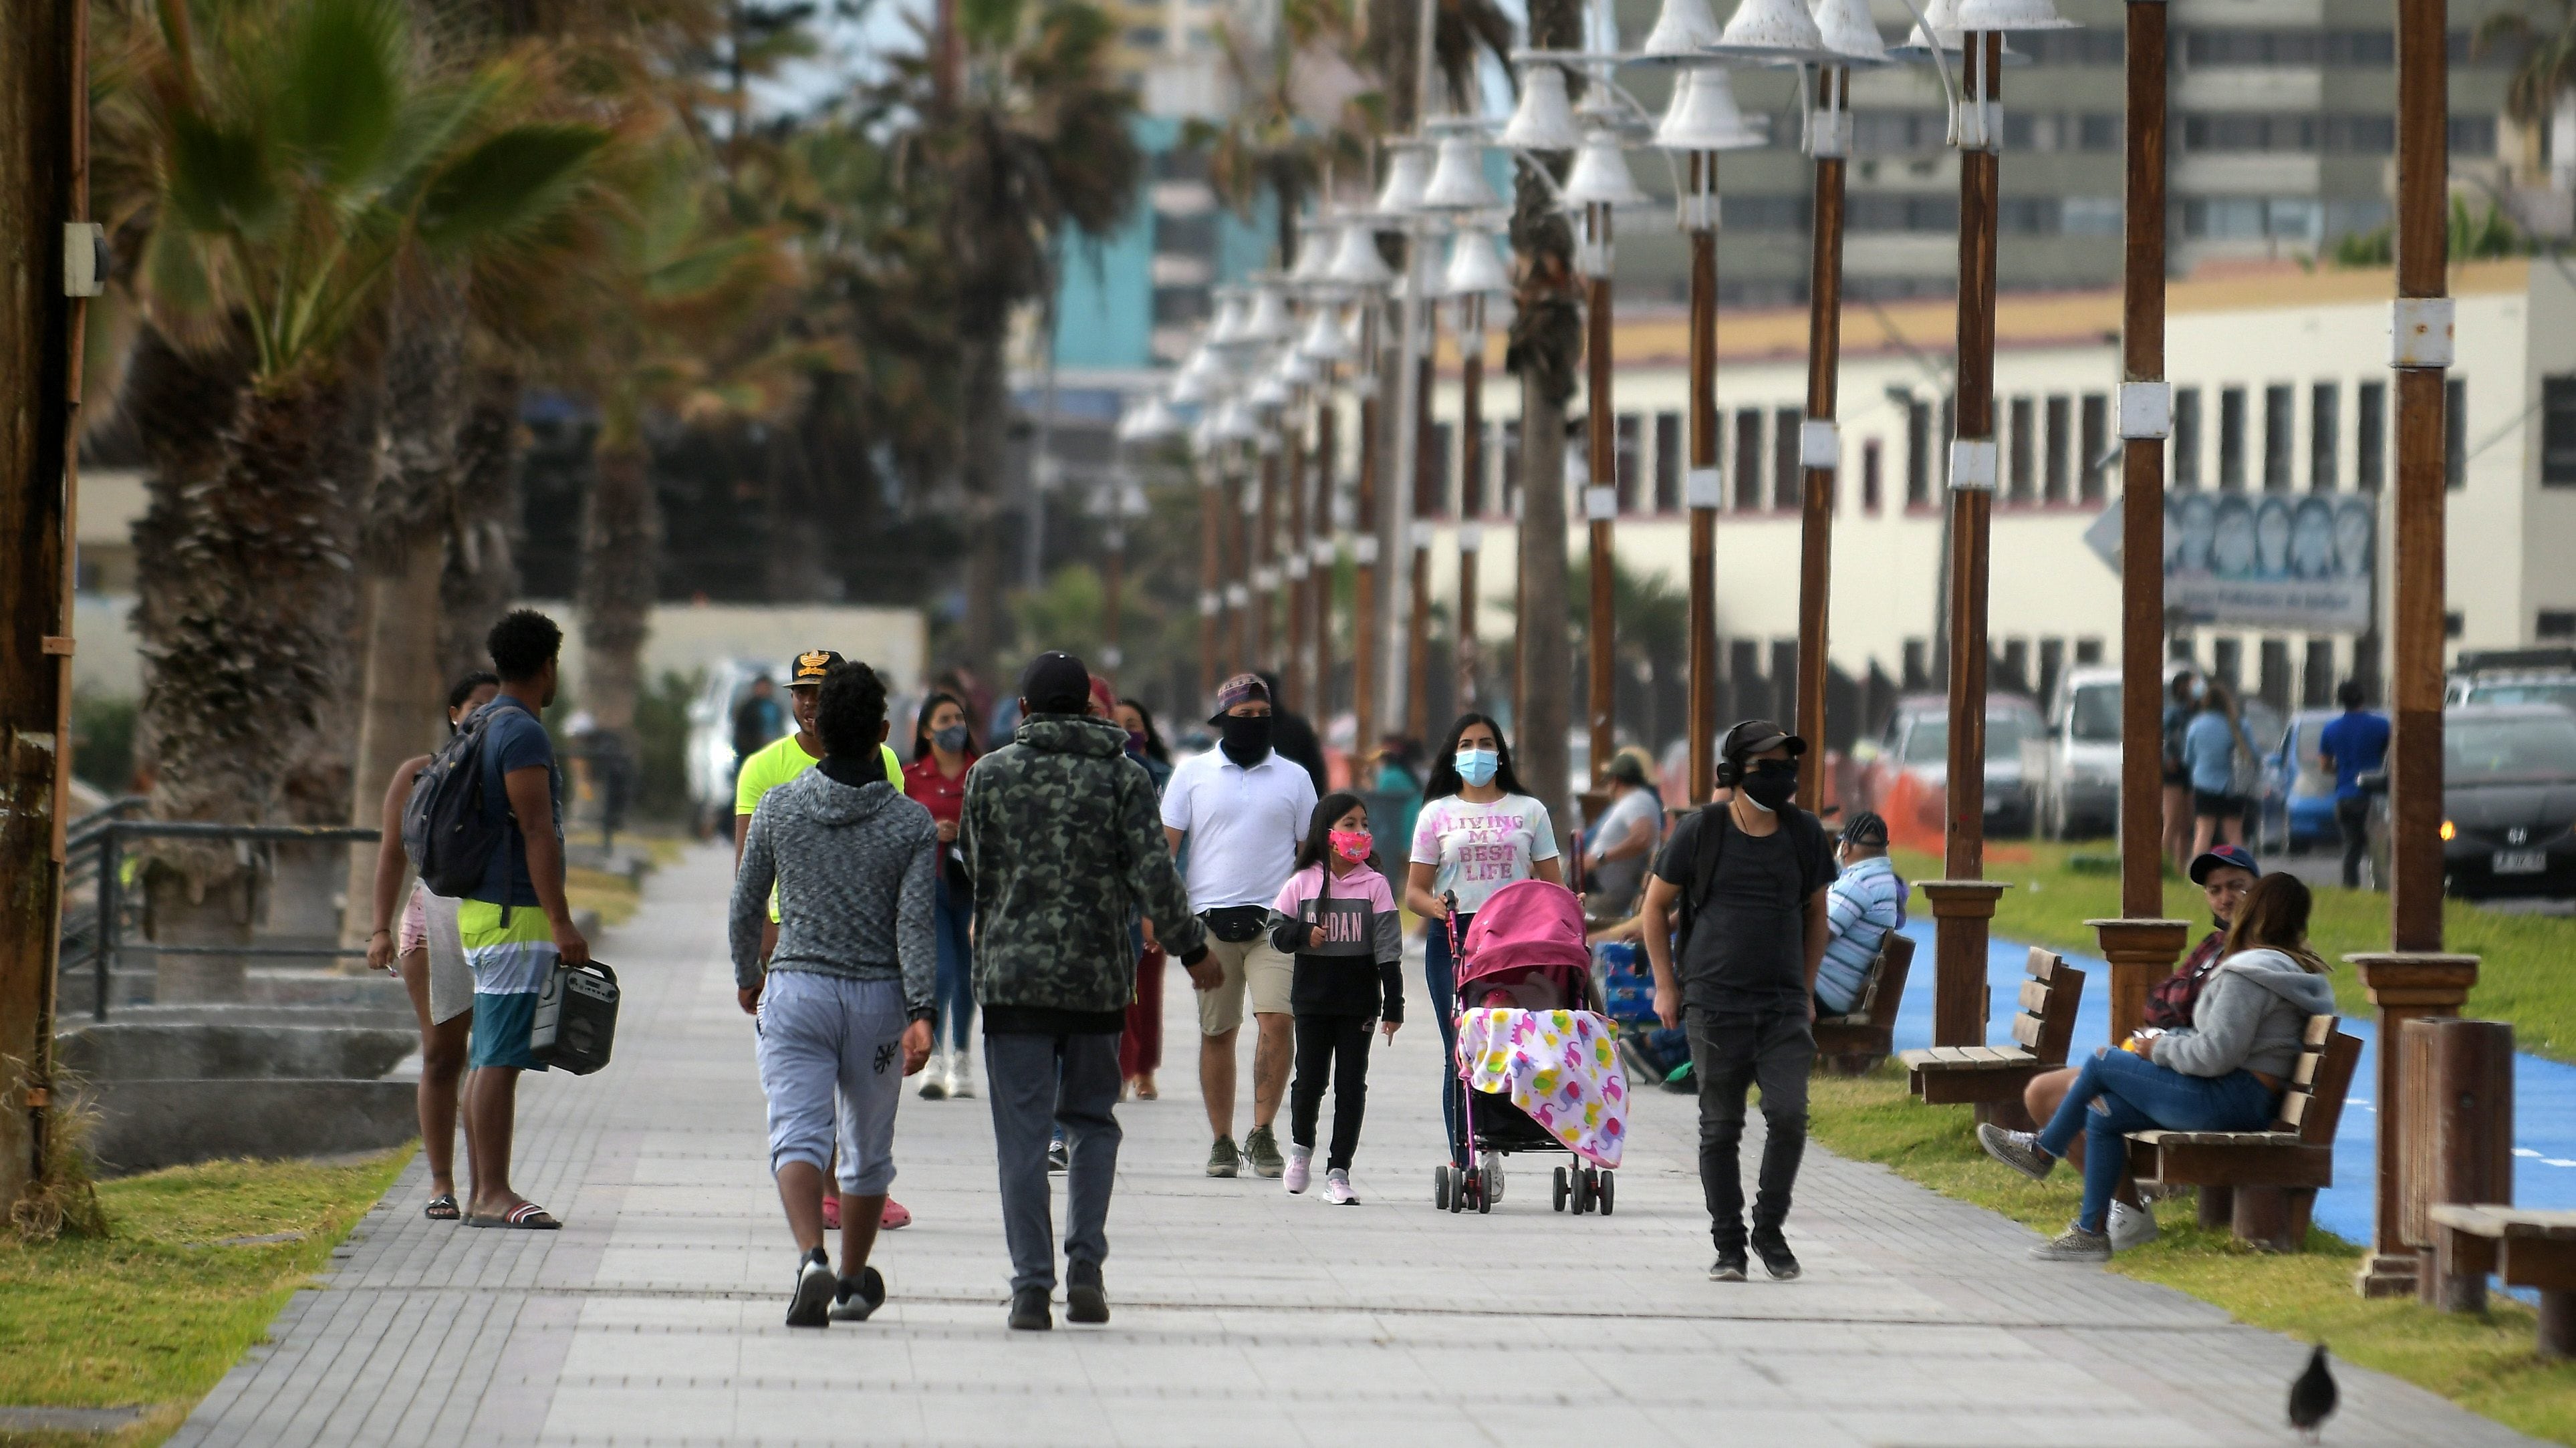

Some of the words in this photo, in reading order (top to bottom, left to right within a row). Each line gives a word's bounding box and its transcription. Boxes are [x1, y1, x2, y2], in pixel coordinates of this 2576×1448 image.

[1446, 815, 1524, 832] LIVING
[1468, 829, 1505, 844] MY
[1458, 845, 1517, 863] BEST
[1465, 863, 1512, 881] LIFE
